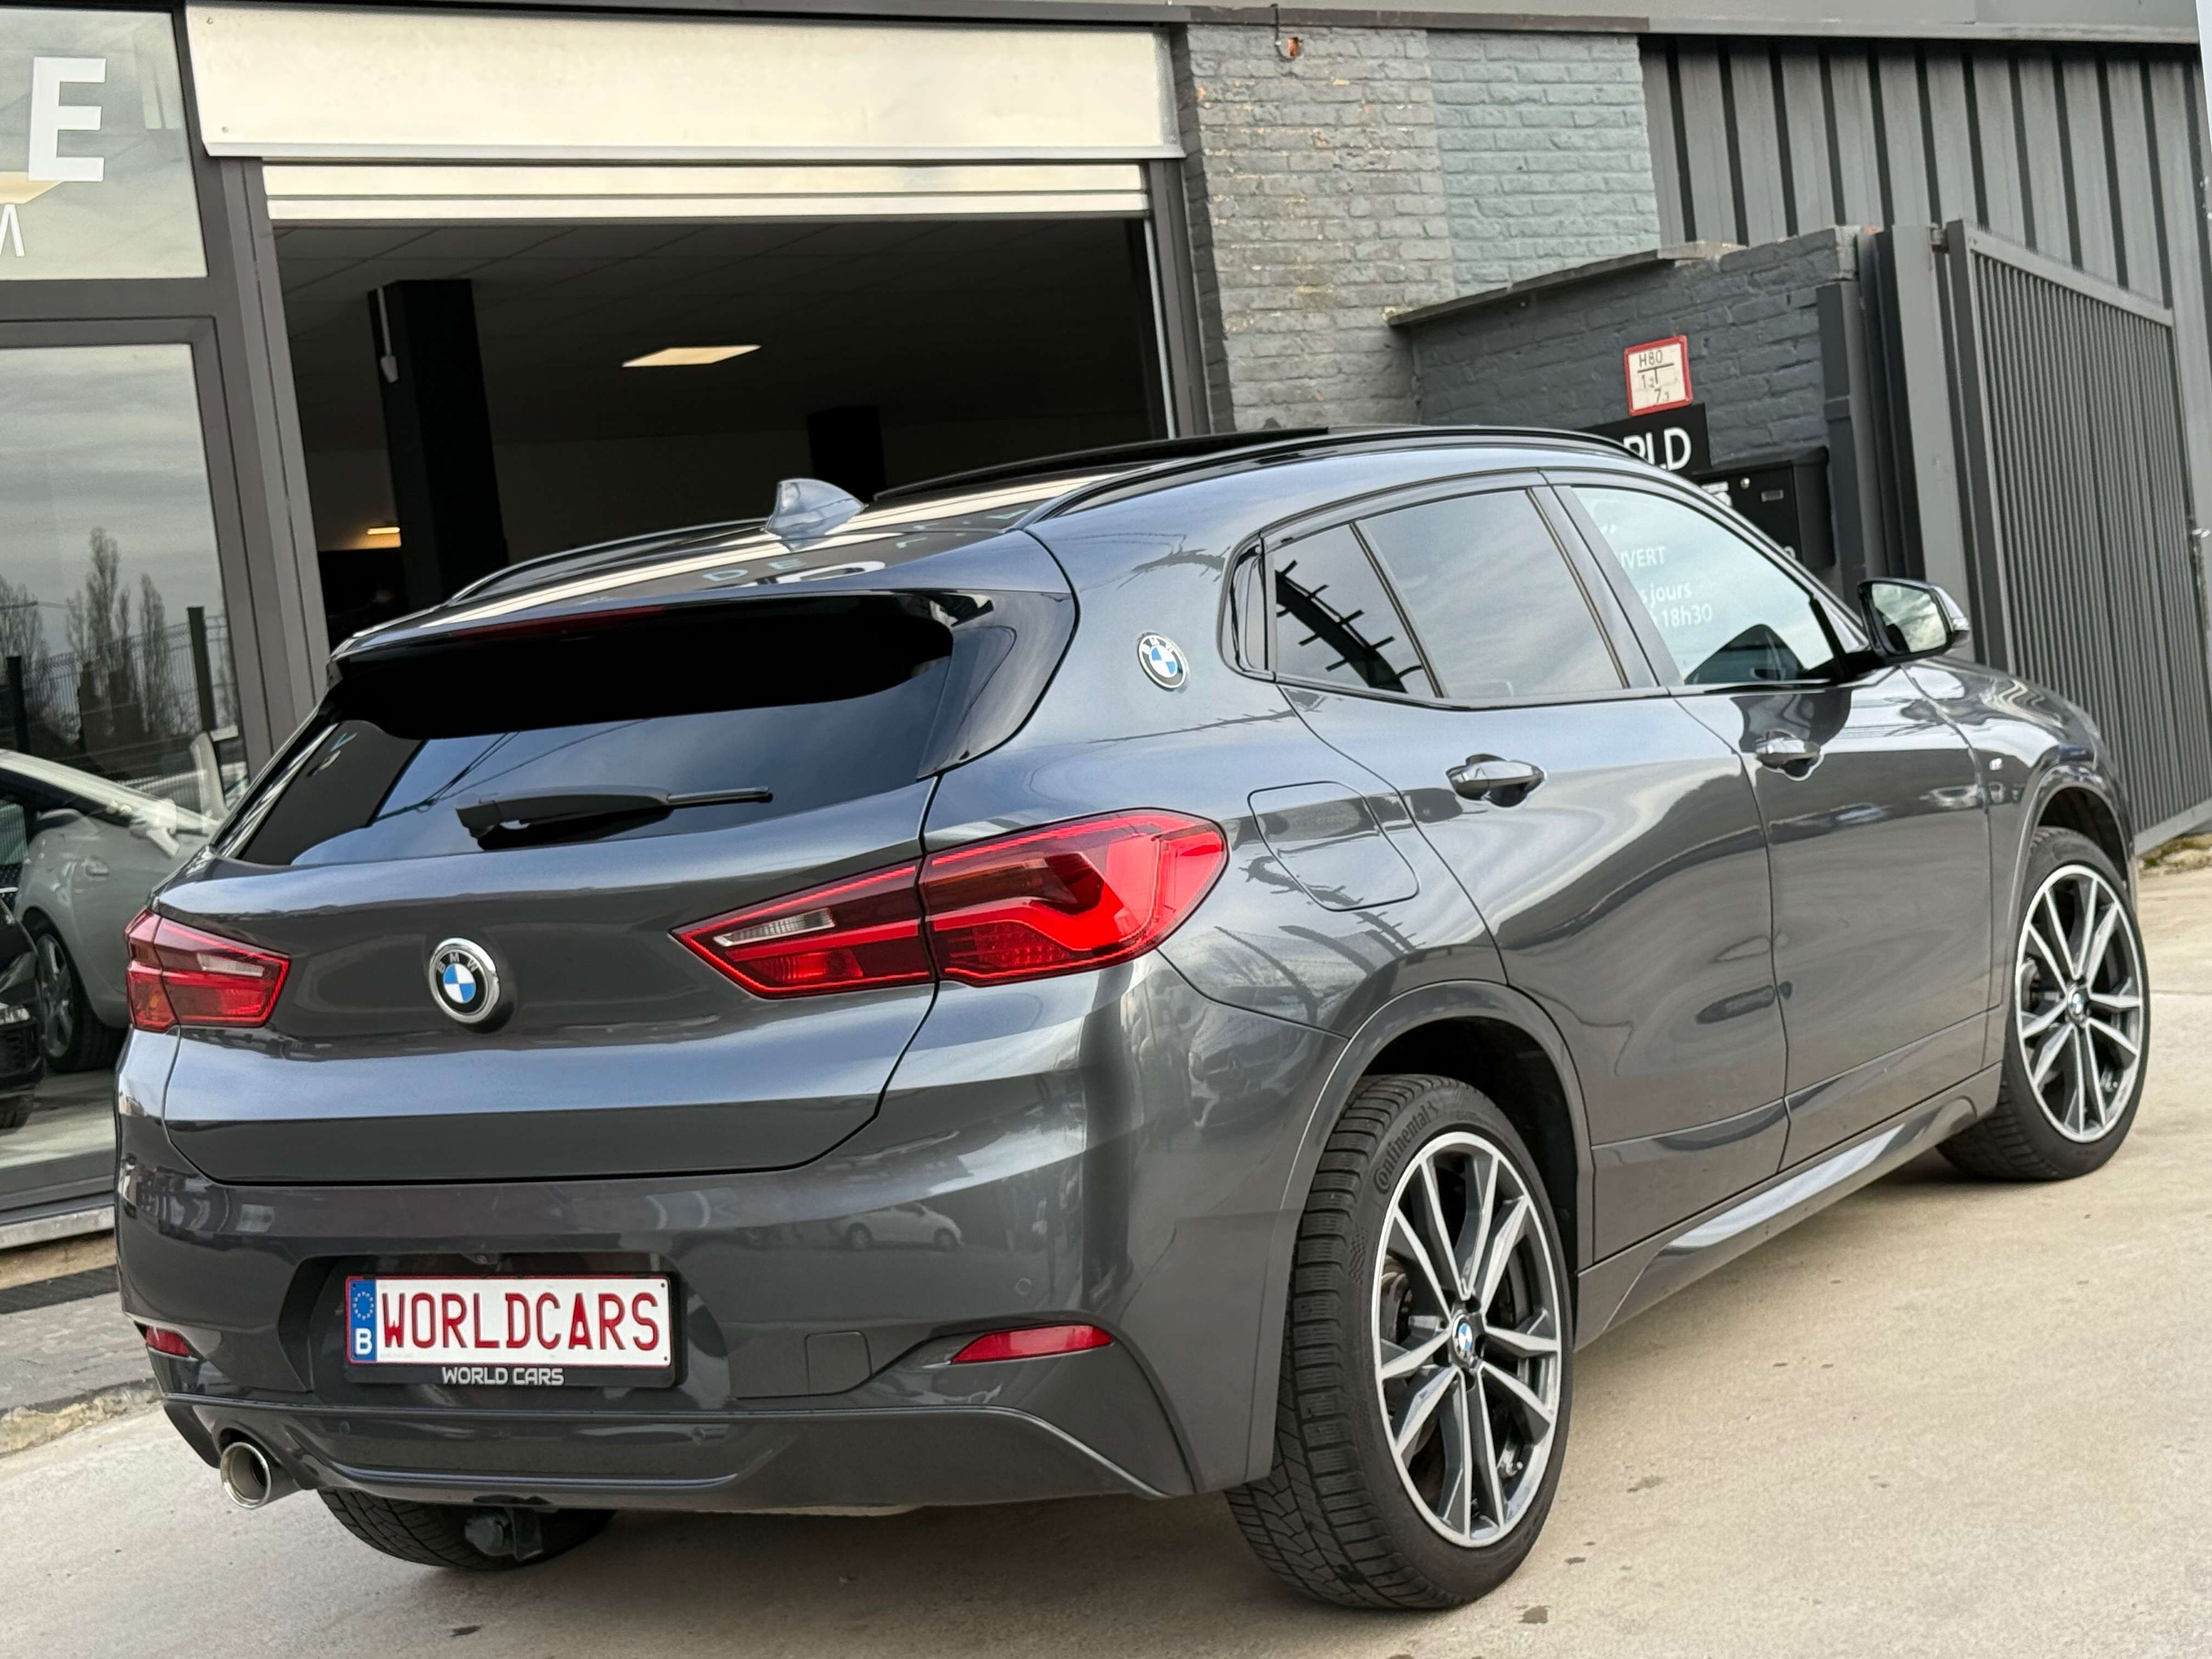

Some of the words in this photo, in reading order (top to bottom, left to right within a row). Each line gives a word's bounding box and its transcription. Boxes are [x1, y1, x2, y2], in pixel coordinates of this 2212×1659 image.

[1639, 349, 1663, 368] H80
[1650, 583, 1691, 608] jours
[1661, 603, 1712, 628] 18h30
[437, 952, 479, 974] BMW
[1373, 1104, 1431, 1194] Continental
[382, 1292, 659, 1351] WORLDCARS
[354, 1328, 373, 1355] B
[442, 1367, 508, 1385] WORLD
[512, 1369, 565, 1386] CARS
